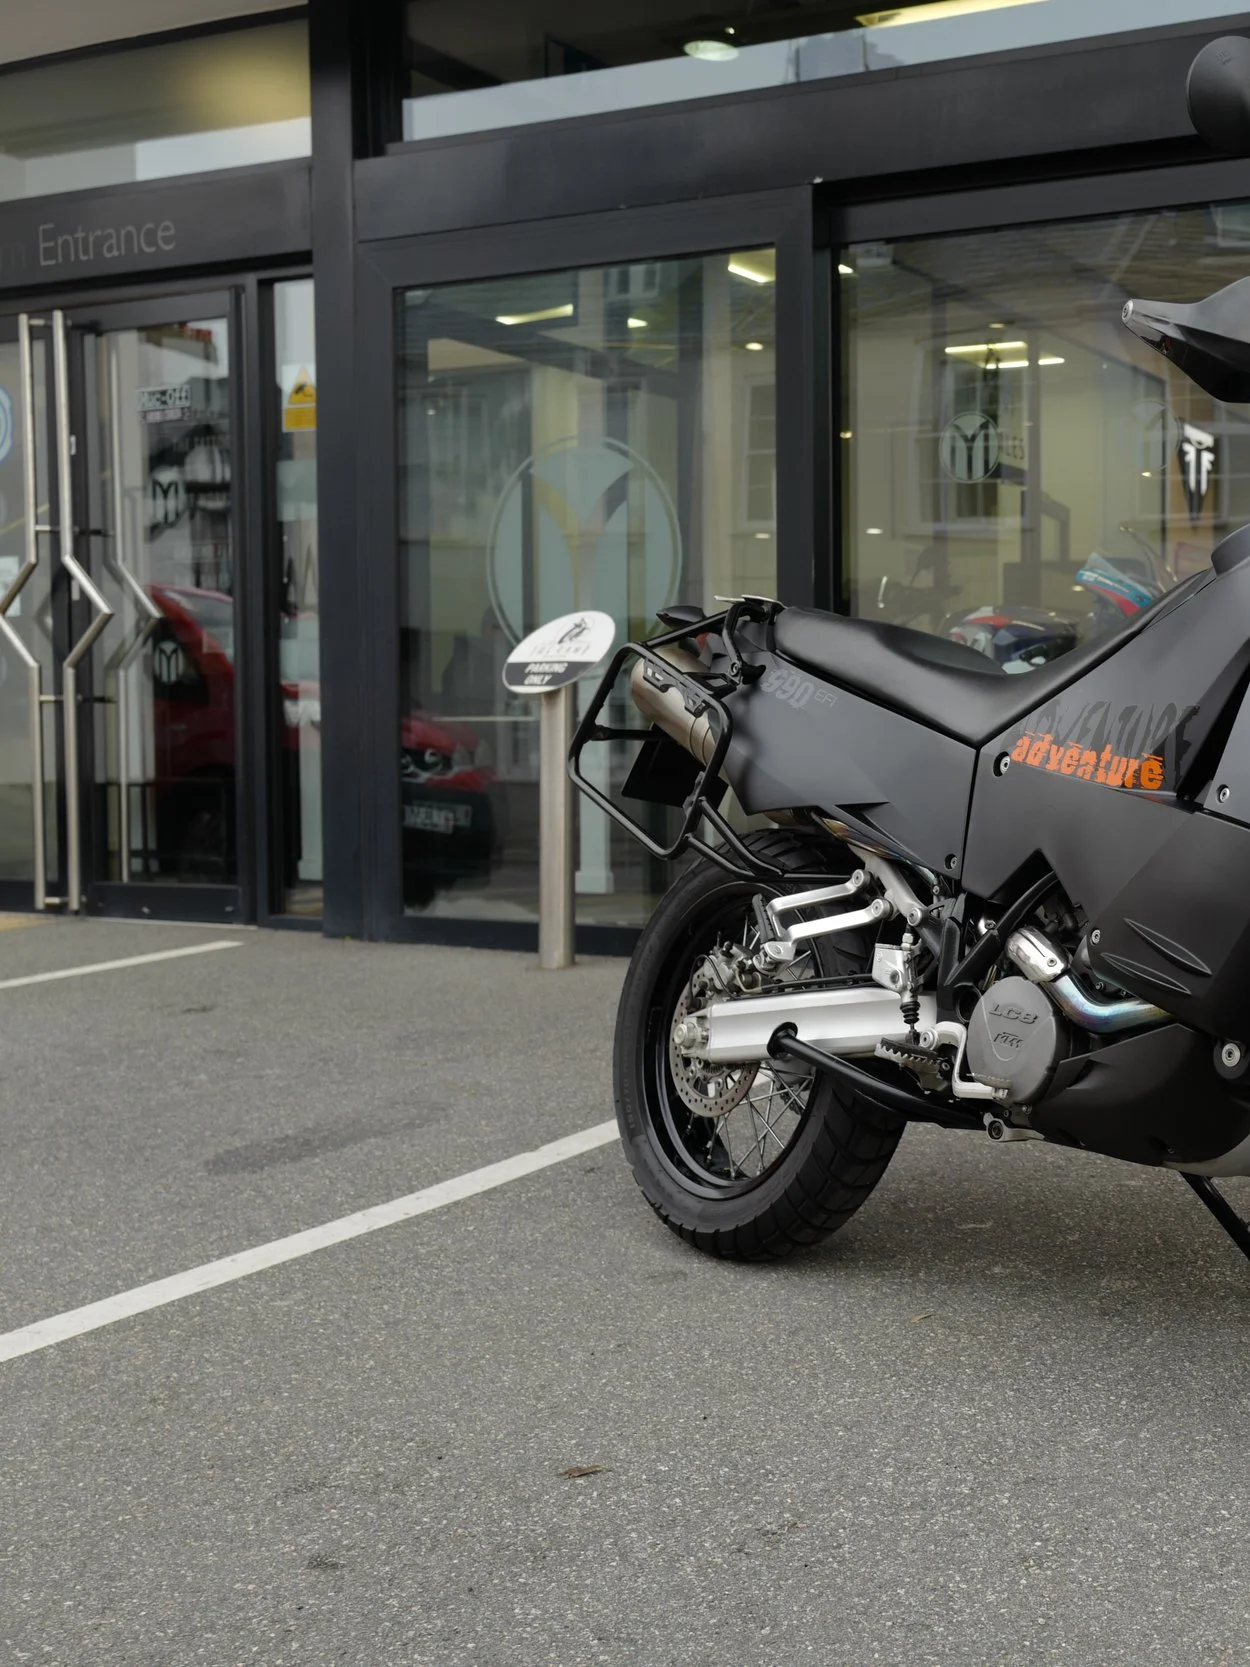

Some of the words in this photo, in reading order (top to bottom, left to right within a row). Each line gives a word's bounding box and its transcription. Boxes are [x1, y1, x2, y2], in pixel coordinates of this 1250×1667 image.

[38, 219, 177, 267] Entrance
[524, 662, 568, 674] PARKING
[523, 674, 553, 686] ONLY
[814, 688, 838, 708] EFI
[1010, 729, 1165, 790] adventure
[988, 1003, 1038, 1025] LC8
